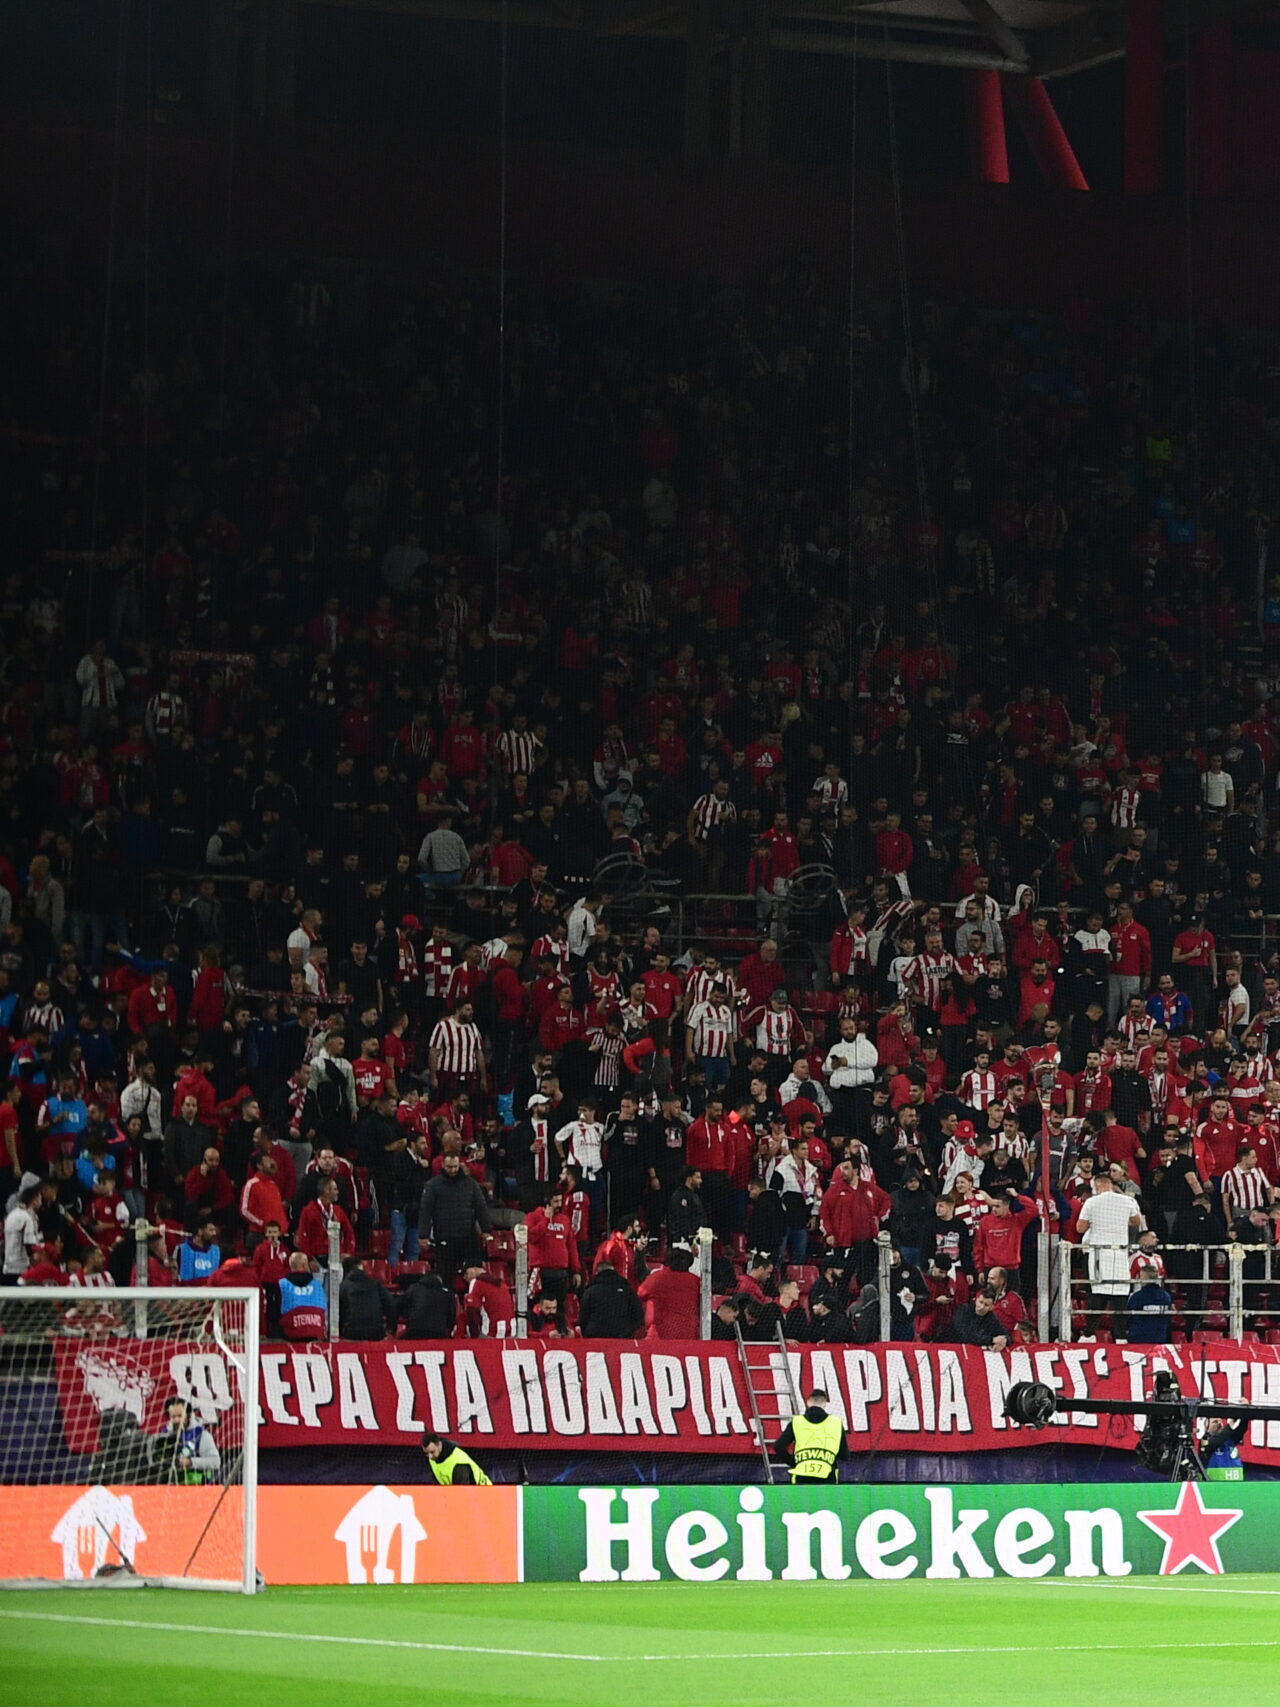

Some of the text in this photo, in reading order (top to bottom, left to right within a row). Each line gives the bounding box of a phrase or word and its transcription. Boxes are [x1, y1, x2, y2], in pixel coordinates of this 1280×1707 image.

[293, 1314, 322, 1328] STEWARD
[386, 1350, 494, 1434] ΣΤΑ
[795, 1449, 836, 1465] STEWARD
[803, 1462, 823, 1474] 157
[1225, 1469, 1240, 1481] HB
[578, 1485, 1132, 1582] Heineken
